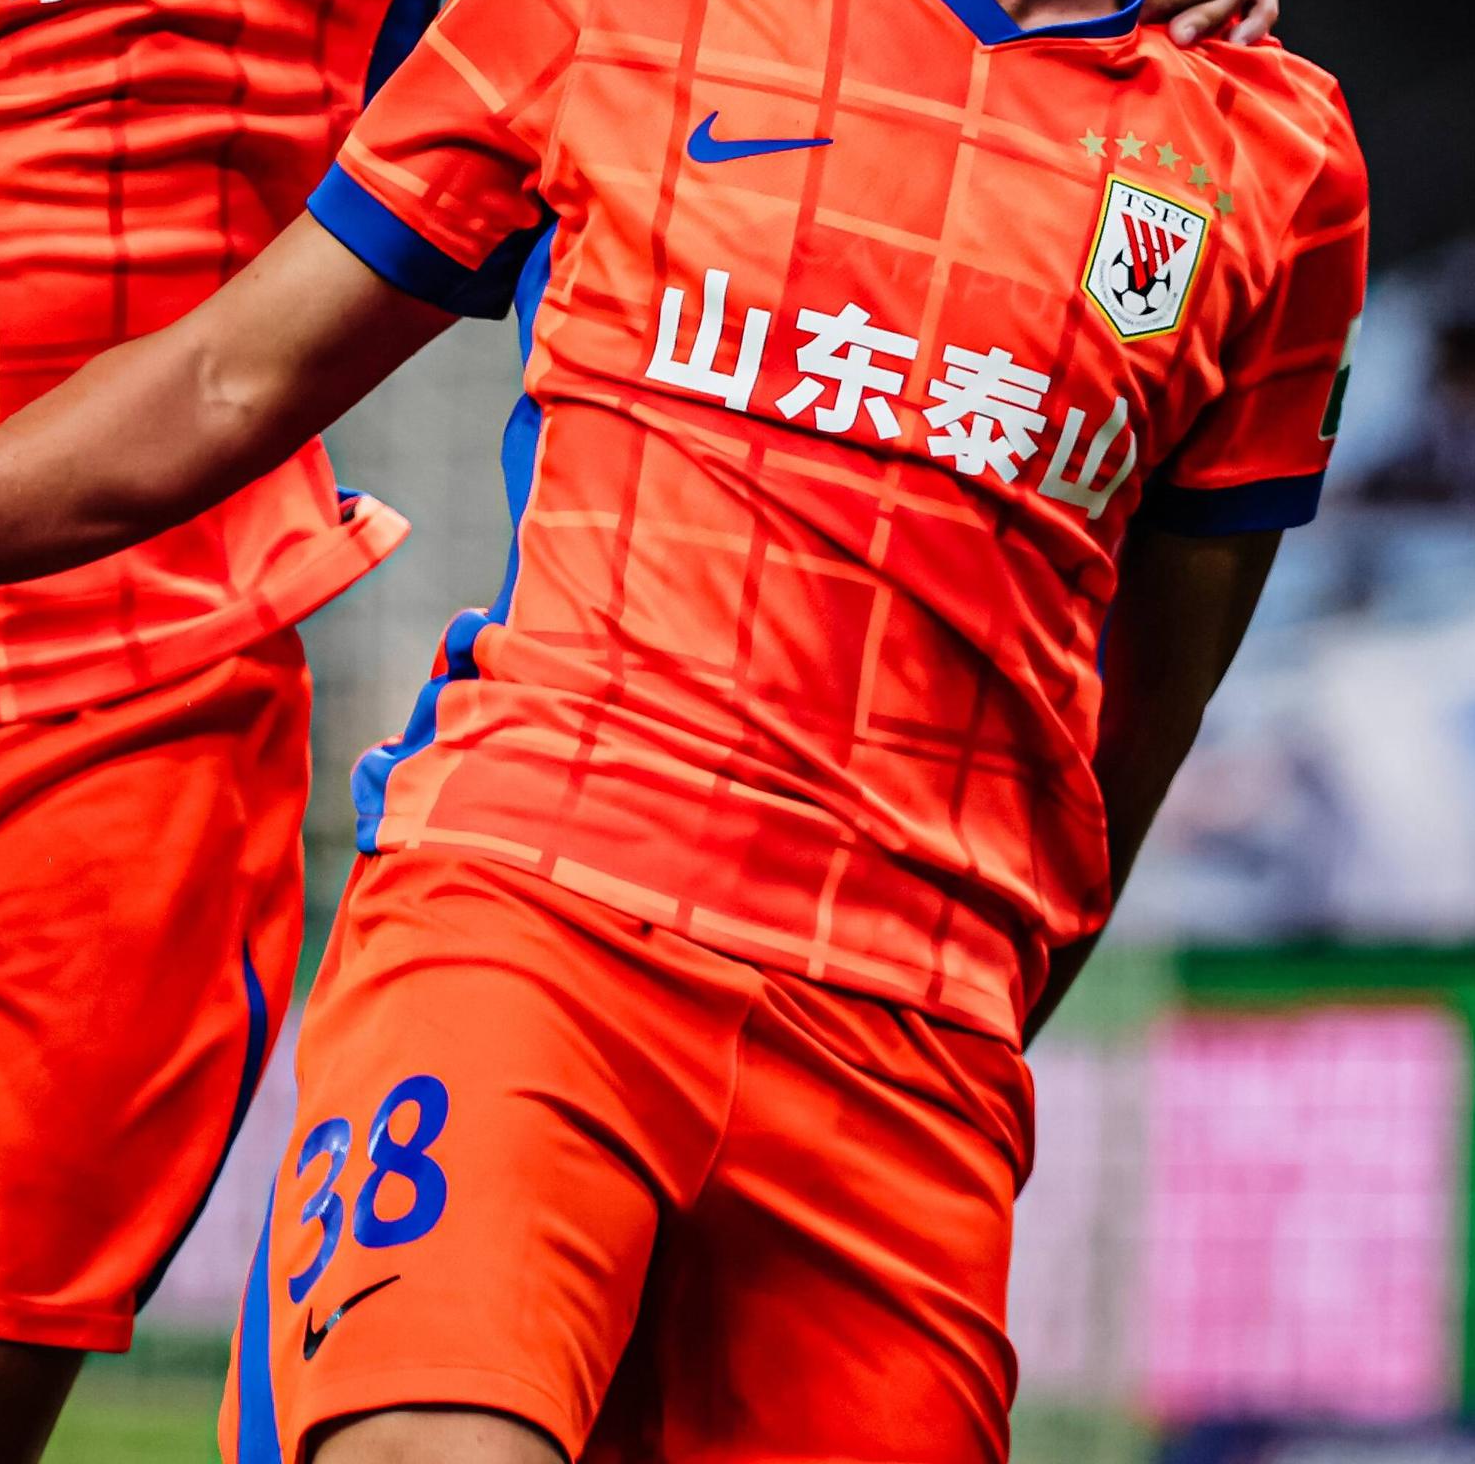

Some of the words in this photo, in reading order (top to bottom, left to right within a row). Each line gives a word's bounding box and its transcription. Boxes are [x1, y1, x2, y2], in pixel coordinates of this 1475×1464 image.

[1121, 189, 1196, 234] TSFC
[644, 268, 1137, 520] 山东泰山
[288, 1074, 449, 1304] 38
